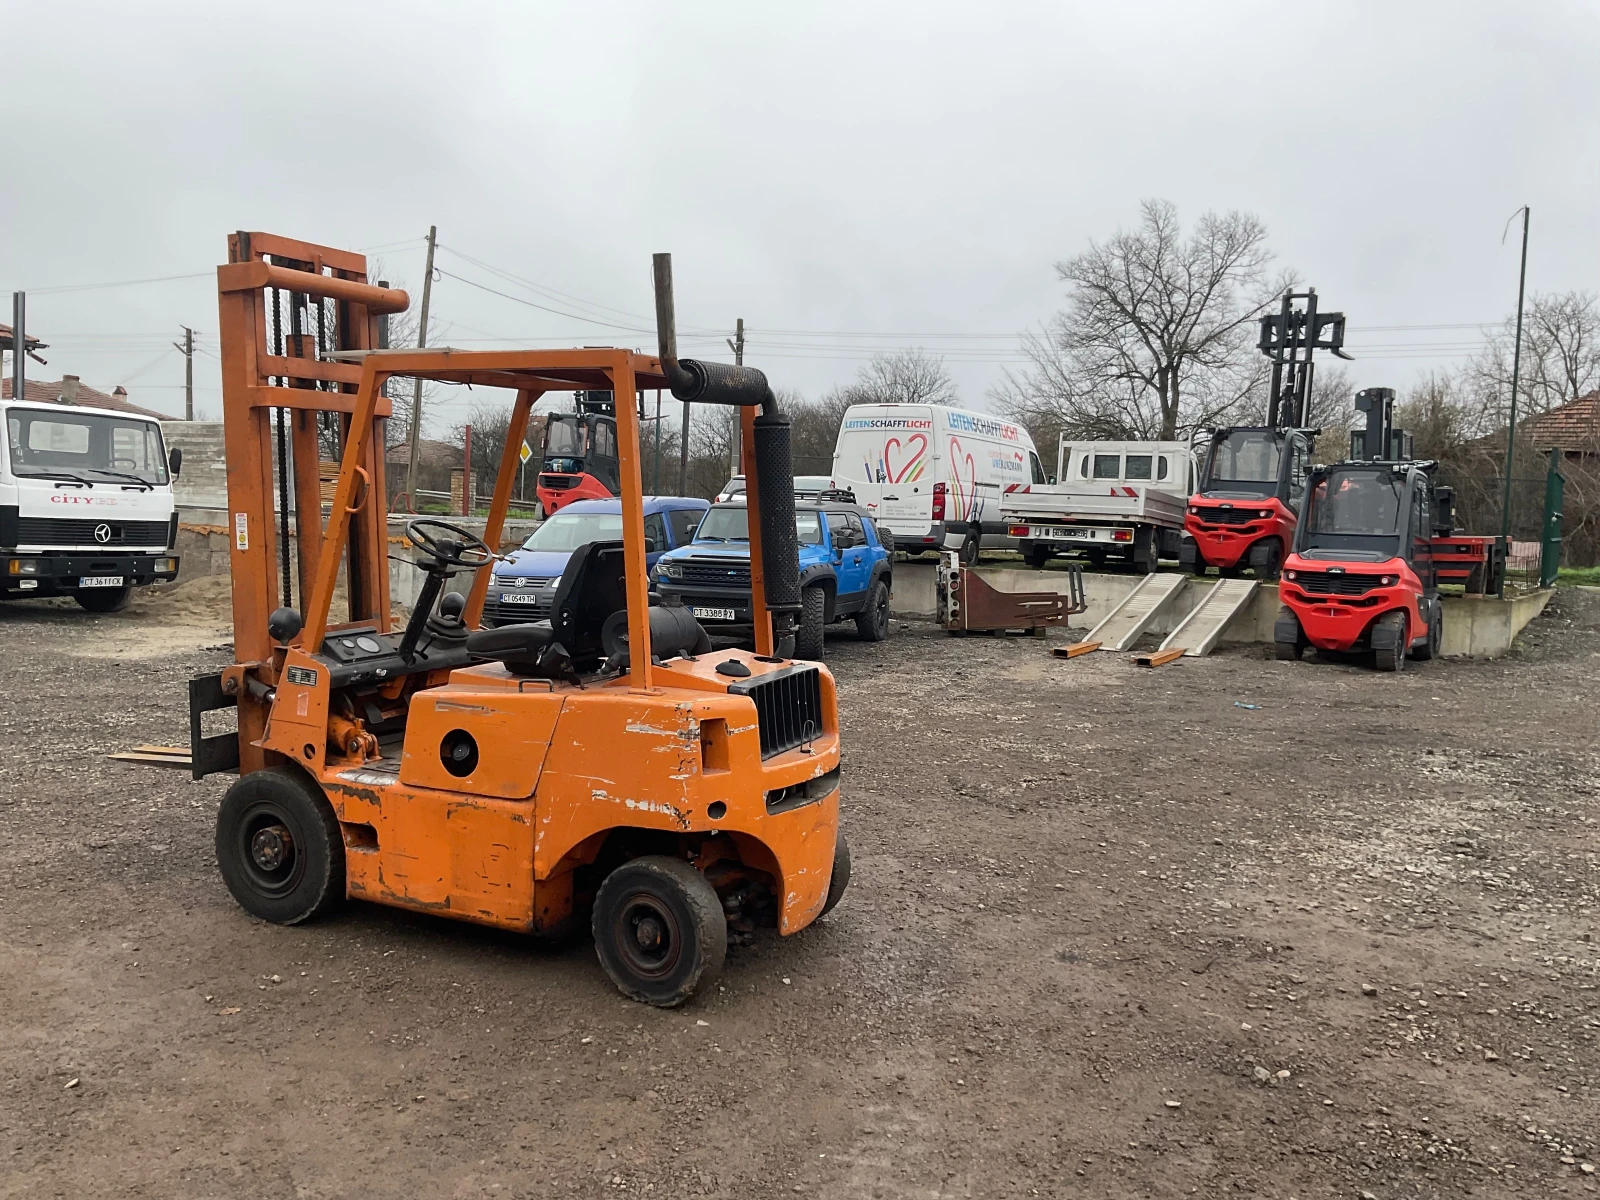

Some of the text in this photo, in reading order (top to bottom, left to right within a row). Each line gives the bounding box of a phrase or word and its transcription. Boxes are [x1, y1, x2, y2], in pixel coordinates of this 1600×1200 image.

[844, 420, 932, 430] LEITENSCHAFFTLICHT
[947, 411, 1019, 442] LEITENSCHAFFTLICHT
[503, 594, 511, 602] CT
[693, 608, 703, 616] CT
[704, 609, 722, 617] 3388
